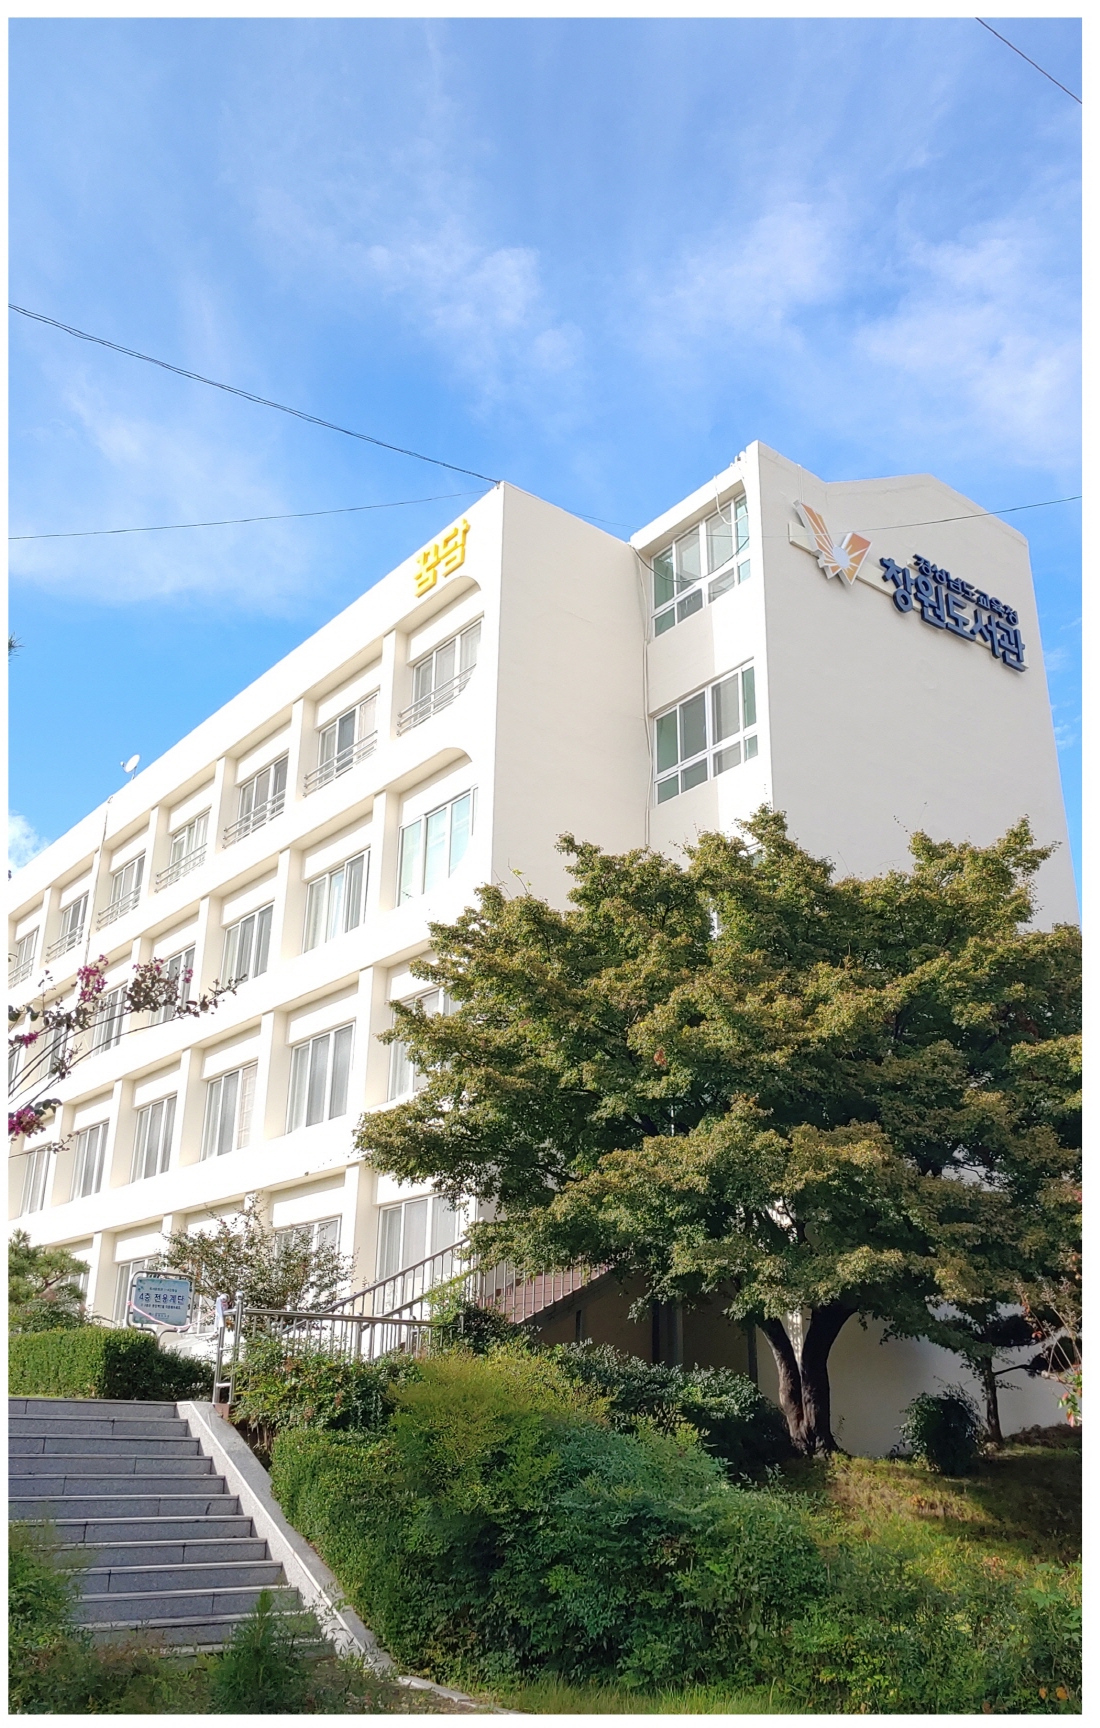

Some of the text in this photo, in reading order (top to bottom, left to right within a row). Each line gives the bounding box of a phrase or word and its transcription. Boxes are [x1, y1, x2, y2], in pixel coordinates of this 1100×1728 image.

[413, 518, 471, 598] 꿈담
[912, 553, 1019, 625] 경상남도교육청
[879, 557, 1026, 672] 창원도서관
